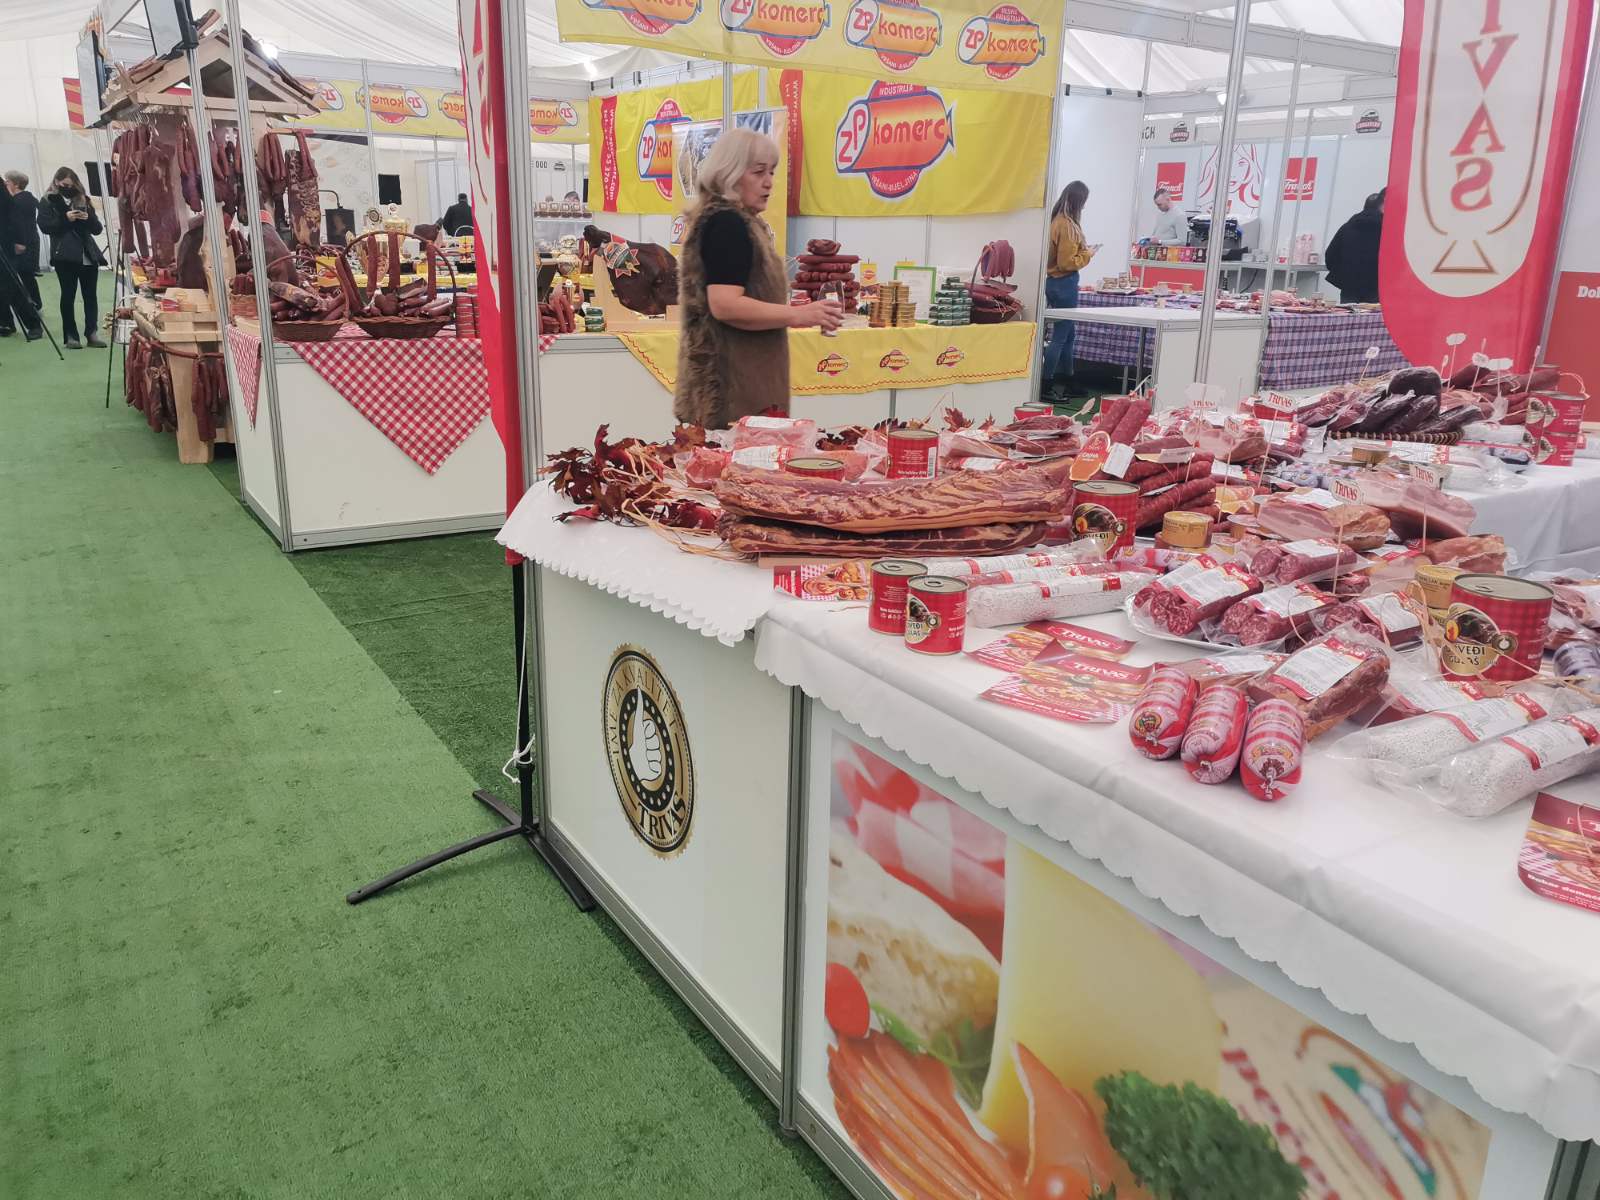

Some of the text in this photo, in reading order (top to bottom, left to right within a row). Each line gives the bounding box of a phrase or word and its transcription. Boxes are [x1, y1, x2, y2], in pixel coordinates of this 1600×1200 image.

[757, 0, 824, 23] komerc
[854, 8, 938, 42] ZP komerc
[965, 28, 985, 49] ZP
[838, 108, 868, 163] ZP
[873, 116, 946, 146] komerc
[642, 136, 654, 159] ZP
[1268, 392, 1293, 408] TRIVAS
[1335, 480, 1358, 501] TRIVAS
[1061, 628, 1111, 647] TRIVAS
[1073, 662, 1129, 679] TRIVAS
[637, 790, 687, 840] TRIVAS
